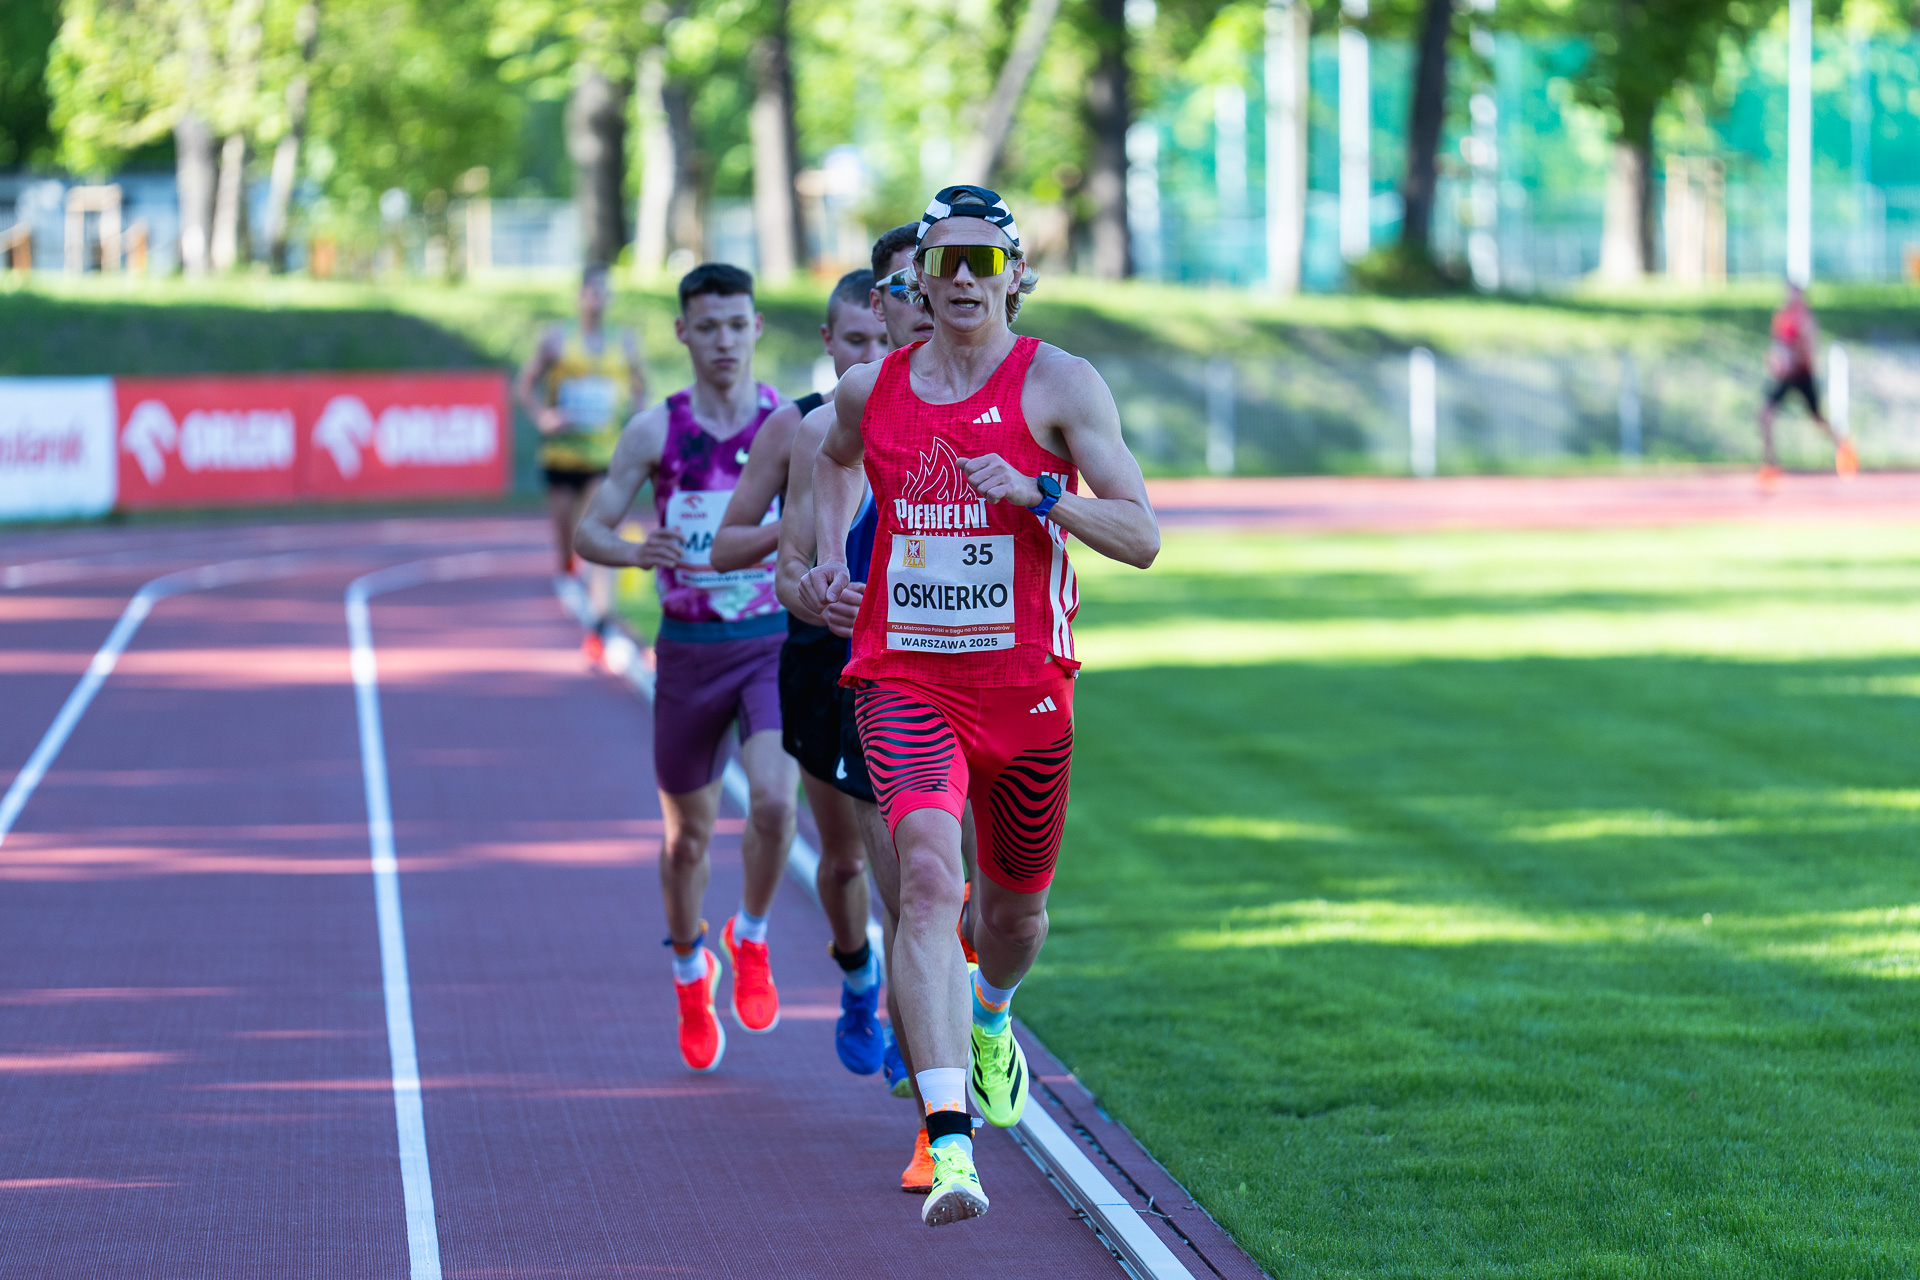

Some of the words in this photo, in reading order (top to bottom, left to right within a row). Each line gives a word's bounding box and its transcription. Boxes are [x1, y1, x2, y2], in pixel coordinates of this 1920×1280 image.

[180, 410, 295, 470] ORLEN
[377, 404, 497, 466] ORLEN
[893, 498, 990, 529] PIEKIELNI
[962, 543, 993, 565] 35
[893, 583, 1008, 610] OSKIERKO
[901, 637, 967, 649] WARSZAWA
[969, 637, 998, 648] 2025
